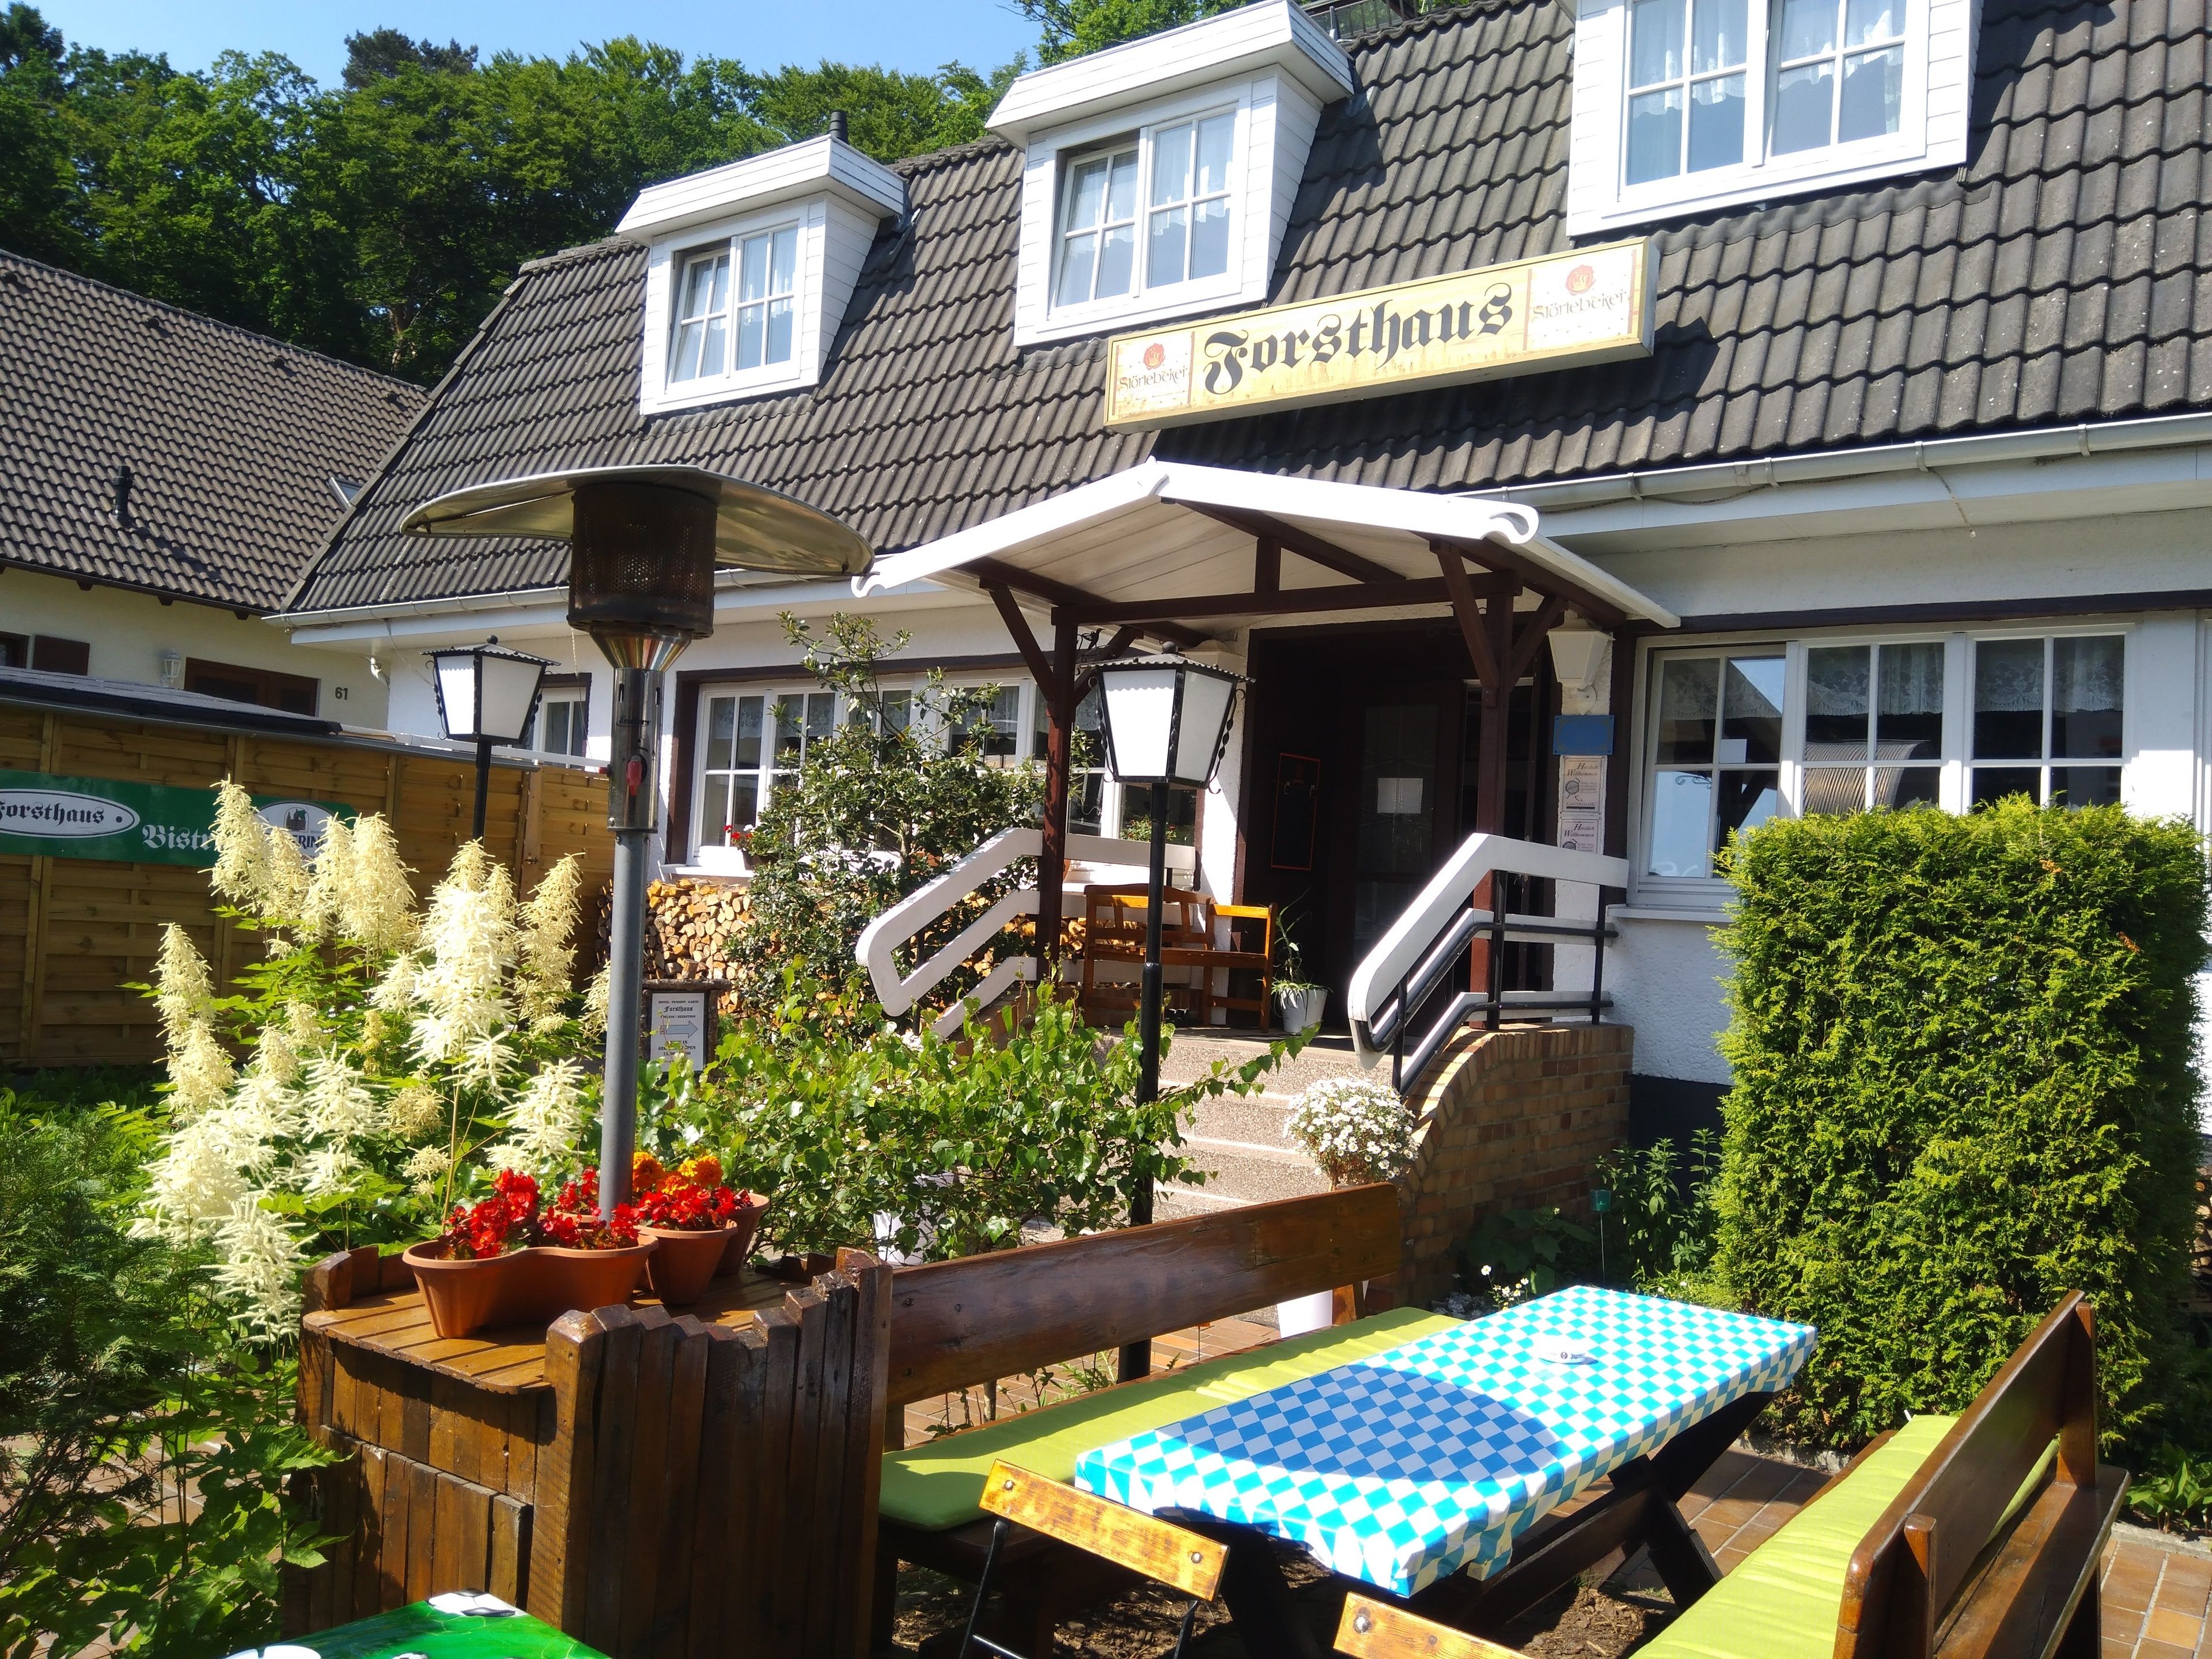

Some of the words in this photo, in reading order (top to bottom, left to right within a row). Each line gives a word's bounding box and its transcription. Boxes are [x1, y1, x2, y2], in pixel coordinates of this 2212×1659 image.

[1203, 282, 1513, 395] Forsthaus
[335, 686, 349, 700] 61
[0, 798, 105, 827] orsthaus
[142, 824, 224, 851] Bistr
